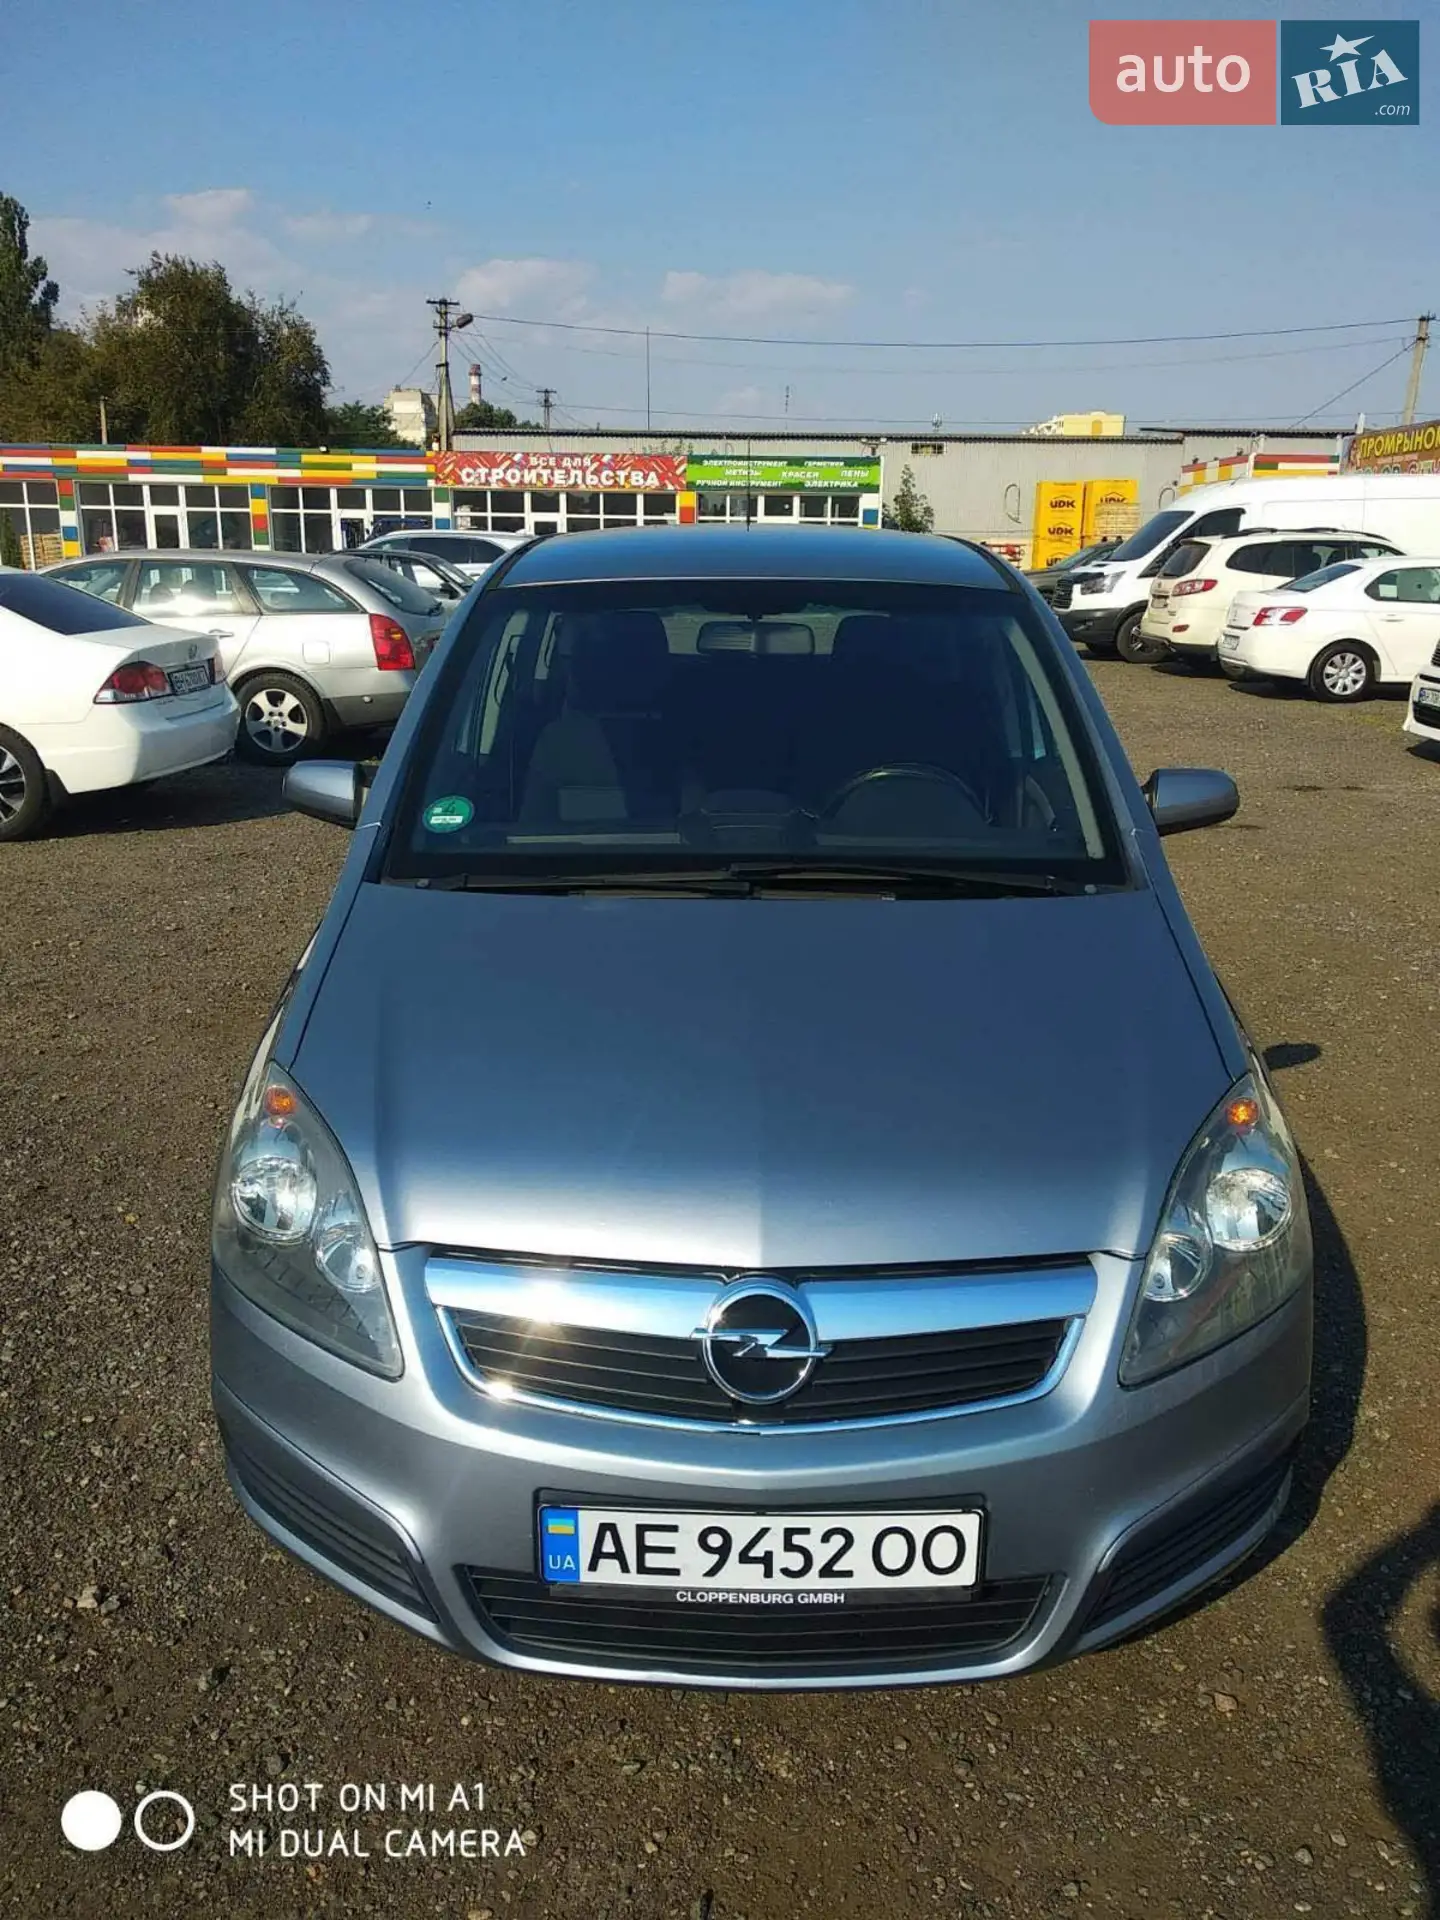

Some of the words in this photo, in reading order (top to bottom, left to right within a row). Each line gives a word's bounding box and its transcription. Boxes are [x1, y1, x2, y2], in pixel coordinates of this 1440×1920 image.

[530, 457, 557, 466] ВСЕ
[562, 458, 592, 467] ДЛЯ
[461, 467, 660, 487] СТРОИТЕЛЬСТВА
[1050, 500, 1076, 508] UDK
[1048, 527, 1075, 535] UDK
[587, 1523, 681, 1577] AE
[697, 1526, 855, 1579] 9452
[871, 1525, 967, 1577] OO
[548, 1555, 576, 1571] UA
[676, 1590, 794, 1604] CLOPPENBURG
[797, 1592, 846, 1604] GMBH
